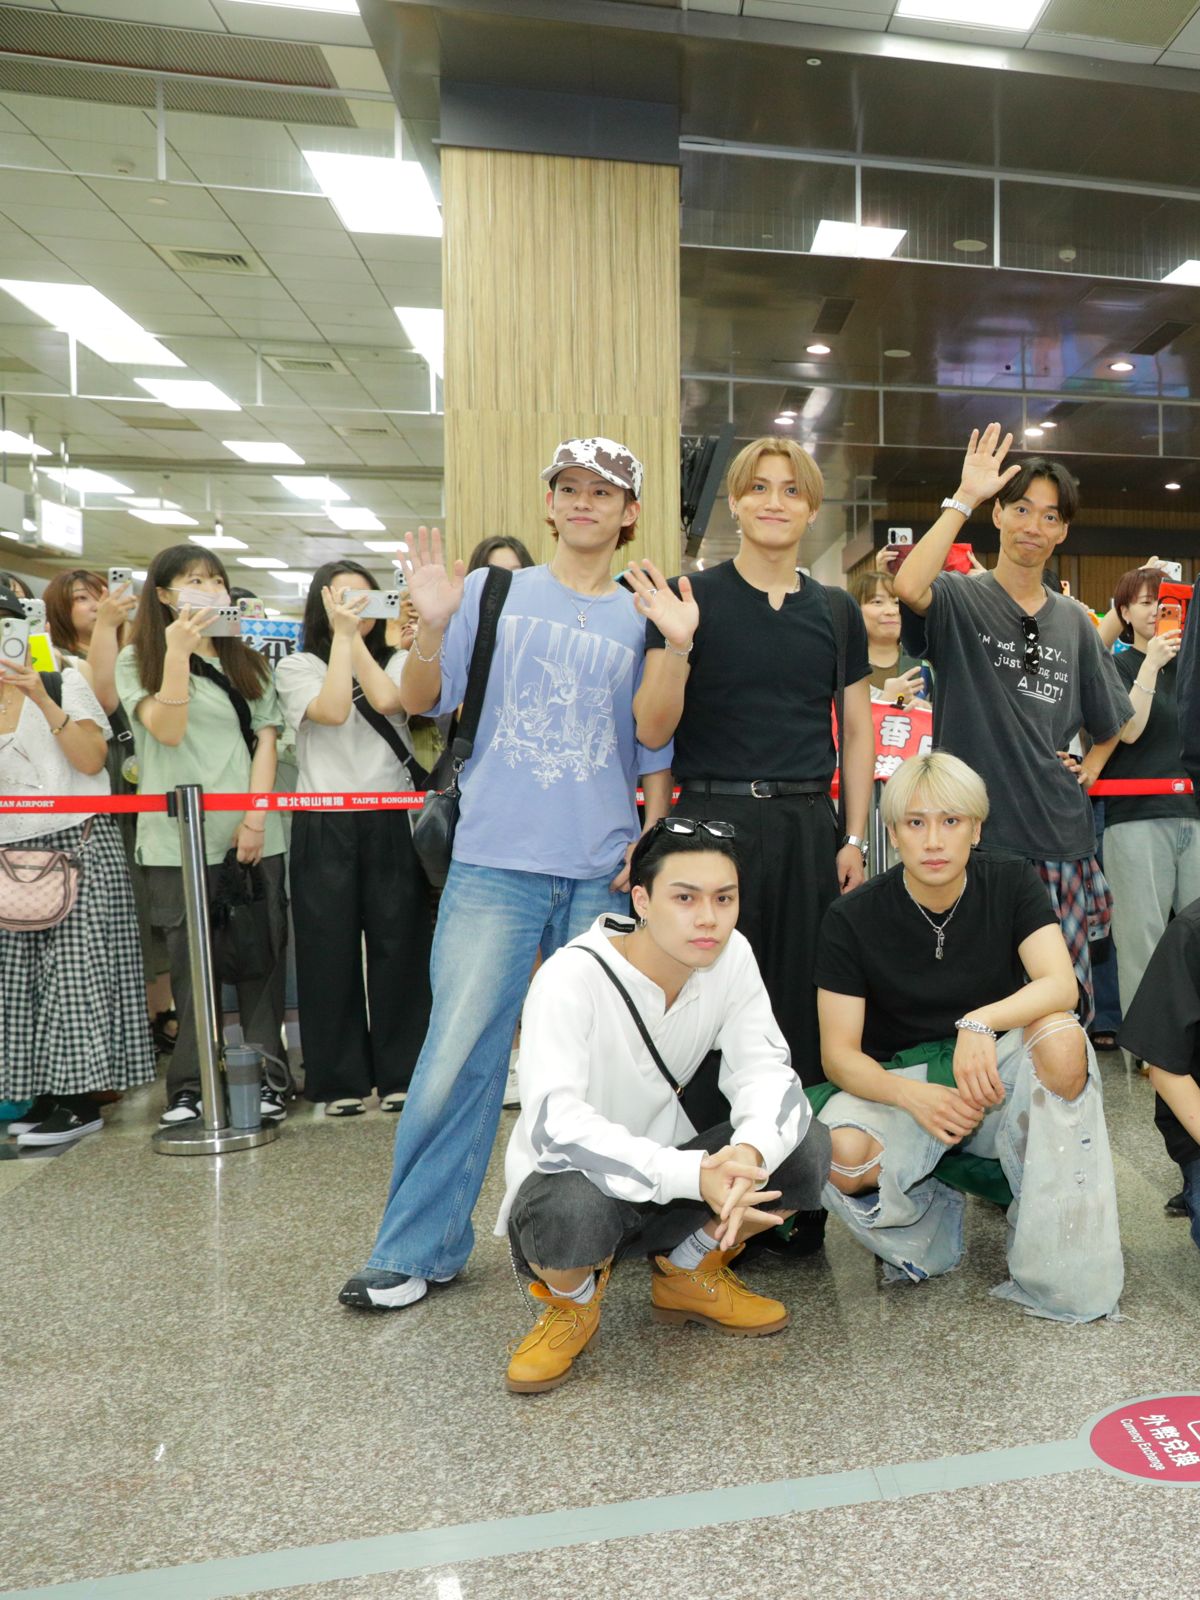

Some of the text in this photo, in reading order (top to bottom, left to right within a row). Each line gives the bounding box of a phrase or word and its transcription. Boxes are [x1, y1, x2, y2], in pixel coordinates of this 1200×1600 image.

[997, 641, 1016, 652] not
[1024, 644, 1068, 664] AZY...
[994, 653, 1022, 669] just
[1054, 672, 1069, 683] out
[1017, 675, 1064, 701] A LOT!
[16, 800, 55, 808] AIRPORT
[352, 797, 378, 805] TAIPEI
[1120, 1418, 1166, 1472] Currency Exchange
